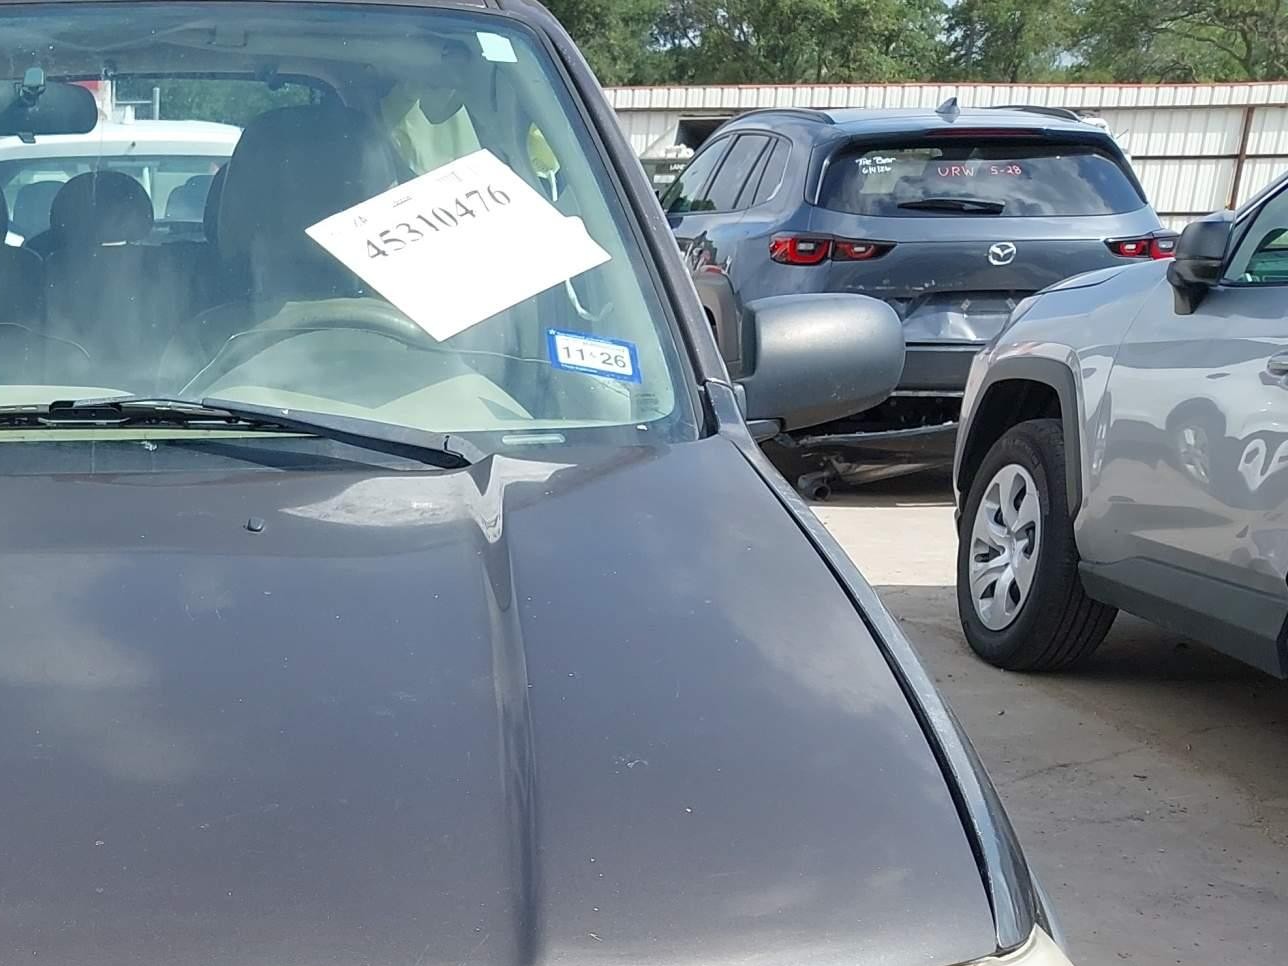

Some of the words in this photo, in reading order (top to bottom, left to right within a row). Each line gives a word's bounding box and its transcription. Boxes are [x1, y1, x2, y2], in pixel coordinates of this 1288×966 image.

[937, 166, 975, 177] URW
[366, 183, 511, 260] 45310476
[562, 346, 585, 361] 11
[599, 351, 627, 369] 26
